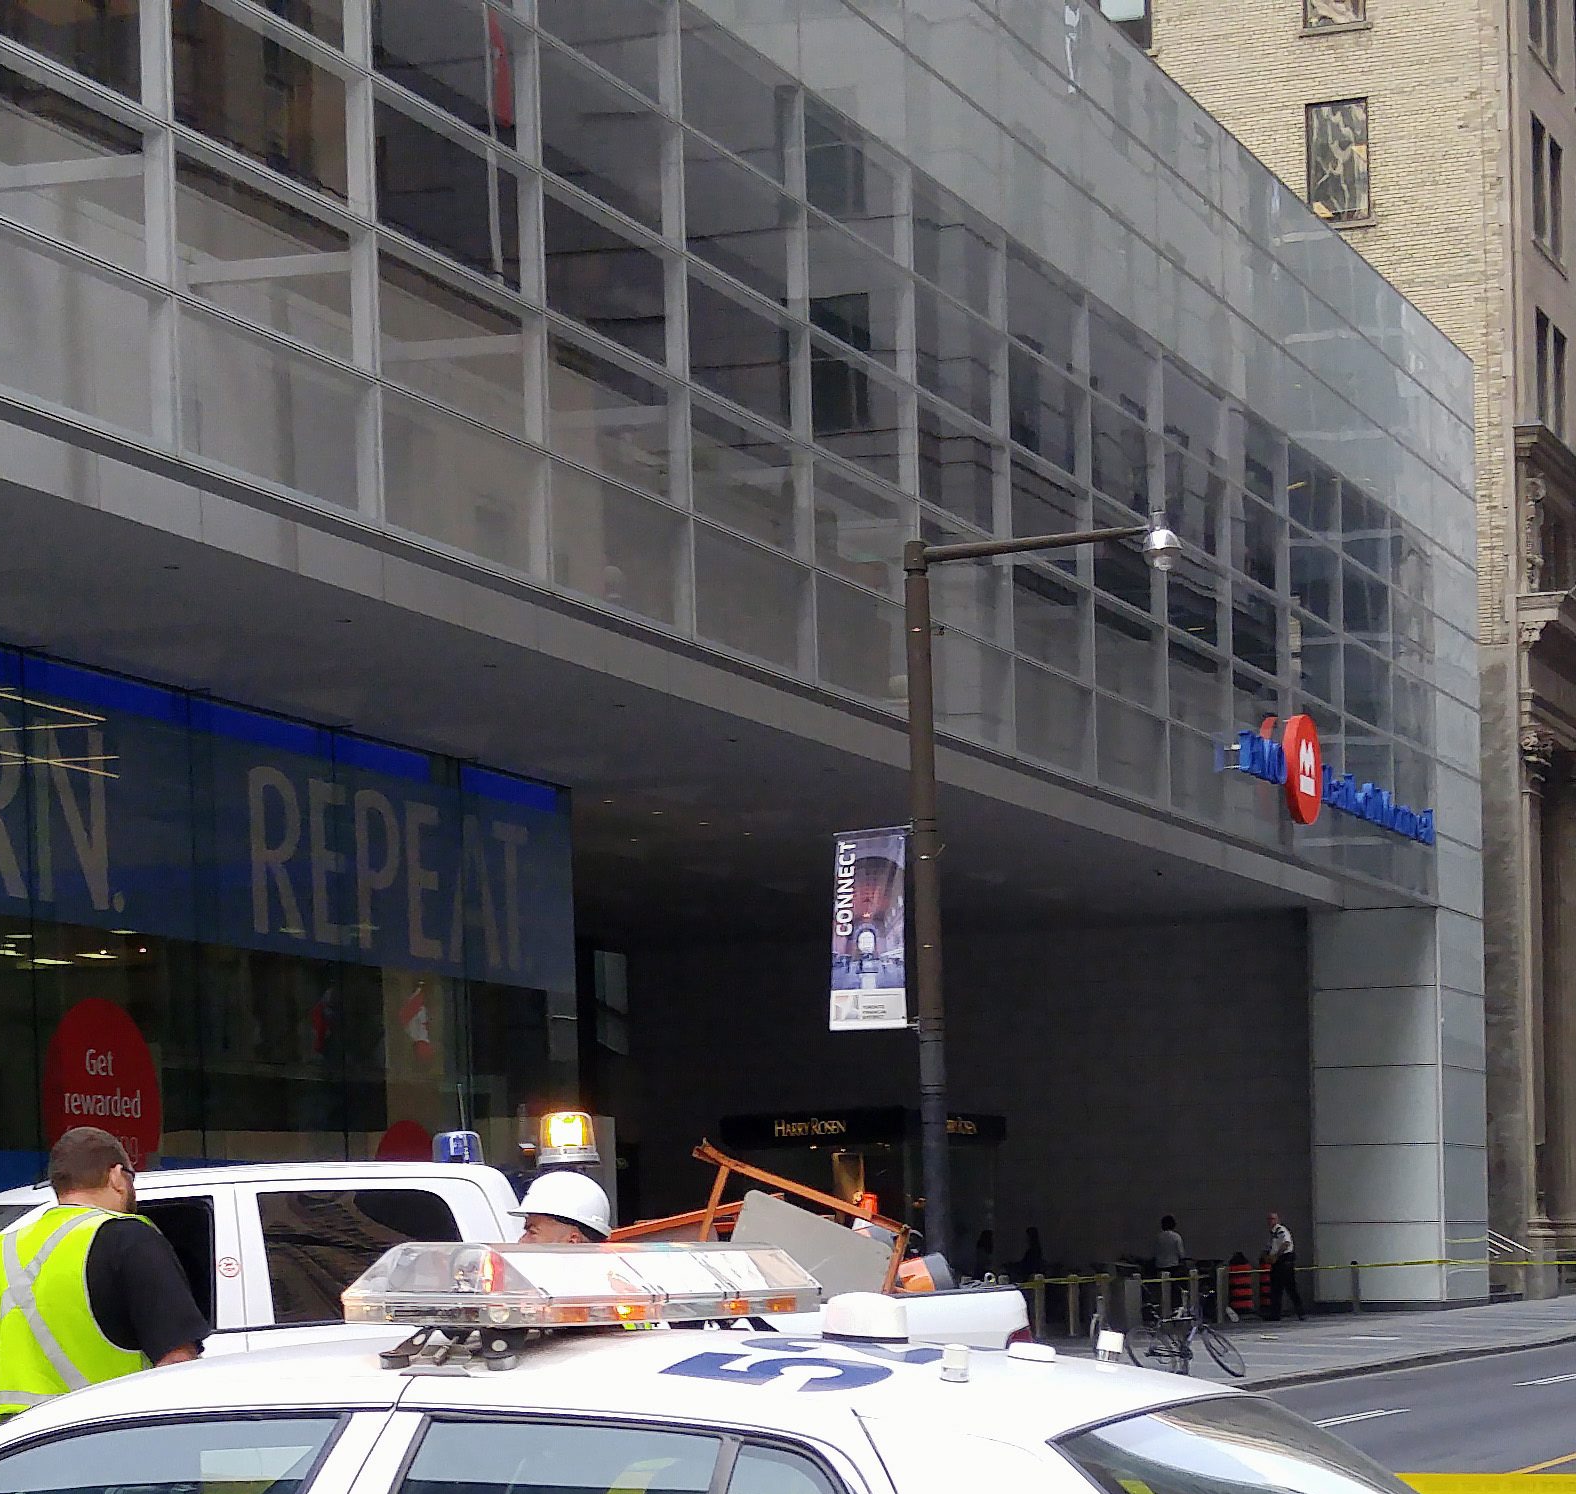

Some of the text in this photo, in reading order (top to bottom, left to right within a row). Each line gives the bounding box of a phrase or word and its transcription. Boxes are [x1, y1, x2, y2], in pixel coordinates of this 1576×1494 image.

[835, 841, 857, 937] CONNECT
[85, 1049, 114, 1077] Get
[64, 1088, 142, 1119] rewarded
